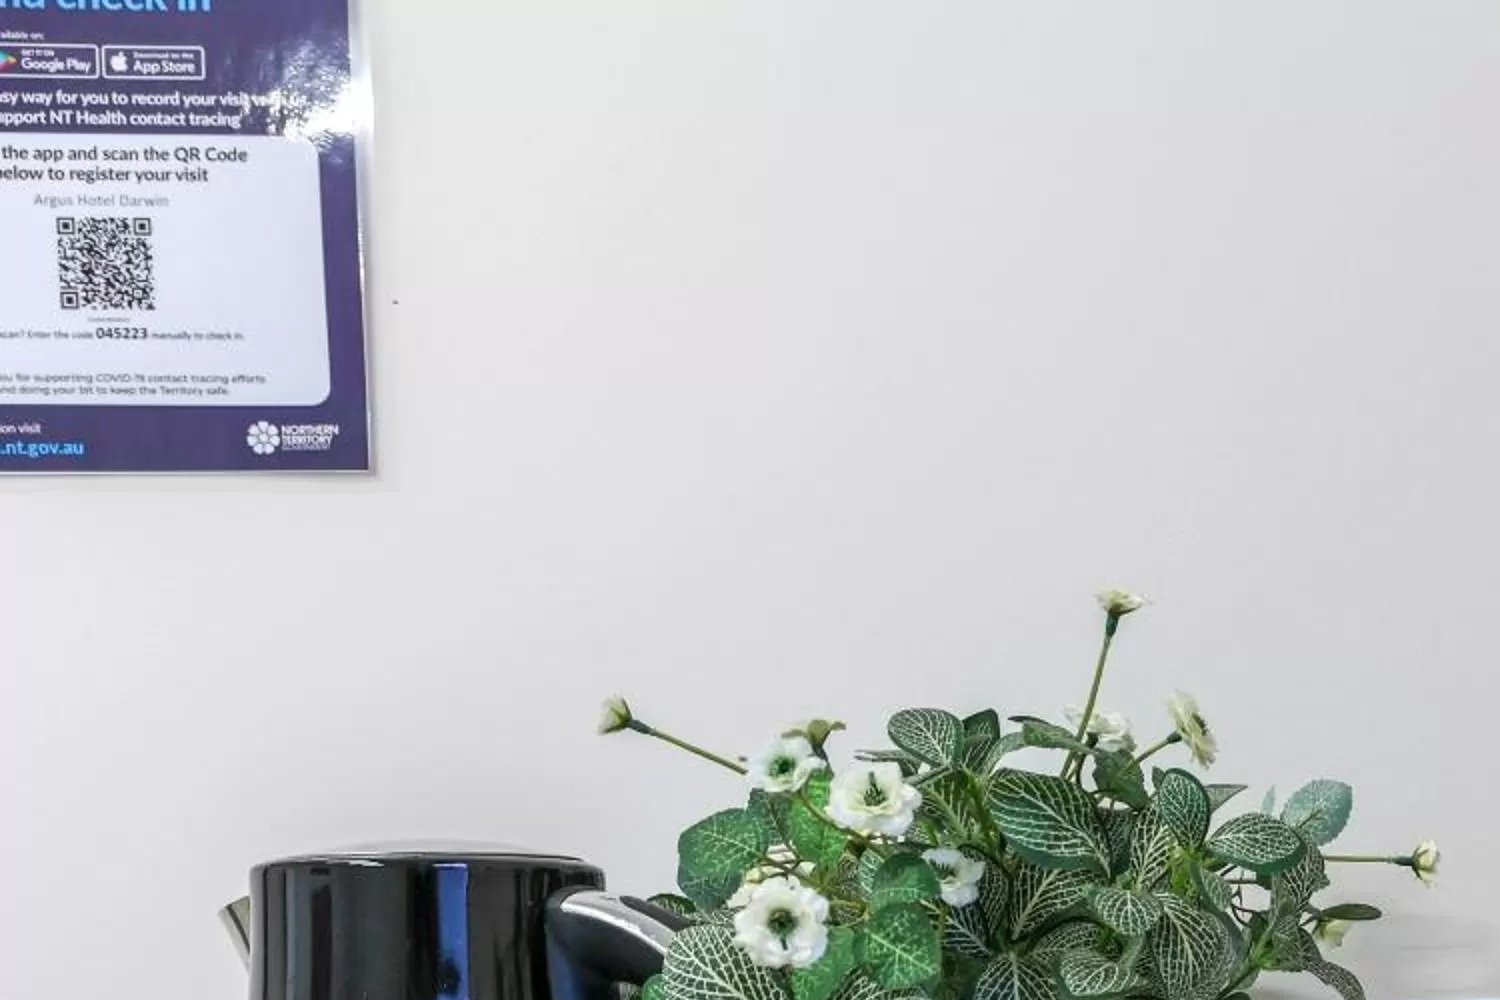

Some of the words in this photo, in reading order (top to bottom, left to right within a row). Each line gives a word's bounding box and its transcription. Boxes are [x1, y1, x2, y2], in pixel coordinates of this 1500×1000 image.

[21, 57, 65, 73] Google
[66, 57, 92, 74] Play
[133, 59, 160, 75] App
[161, 60, 196, 74] Store
[21, 91, 53, 107] way
[56, 89, 78, 105] for
[80, 92, 109, 107] you
[111, 91, 128, 105] to
[131, 91, 180, 107] record
[184, 94, 217, 109] your
[50, 110, 74, 124] NT
[76, 110, 127, 125] Health
[129, 112, 185, 127] contact
[189, 112, 241, 129] tracing
[2, 145, 29, 160] the
[33, 148, 64, 163] app
[67, 145, 98, 161] and
[102, 148, 139, 161] scan
[143, 145, 170, 161] the
[174, 147, 202, 163] QR
[205, 147, 248, 162] Code
[48, 166, 65, 181] to
[69, 165, 130, 184] register
[134, 170, 172, 185] your
[175, 168, 208, 182] visit
[34, 193, 73, 209] Argus
[78, 194, 115, 206] Hotel
[119, 194, 169, 207] Darwin
[95, 327, 148, 339] 045223
[17, 422, 42, 434] visit
